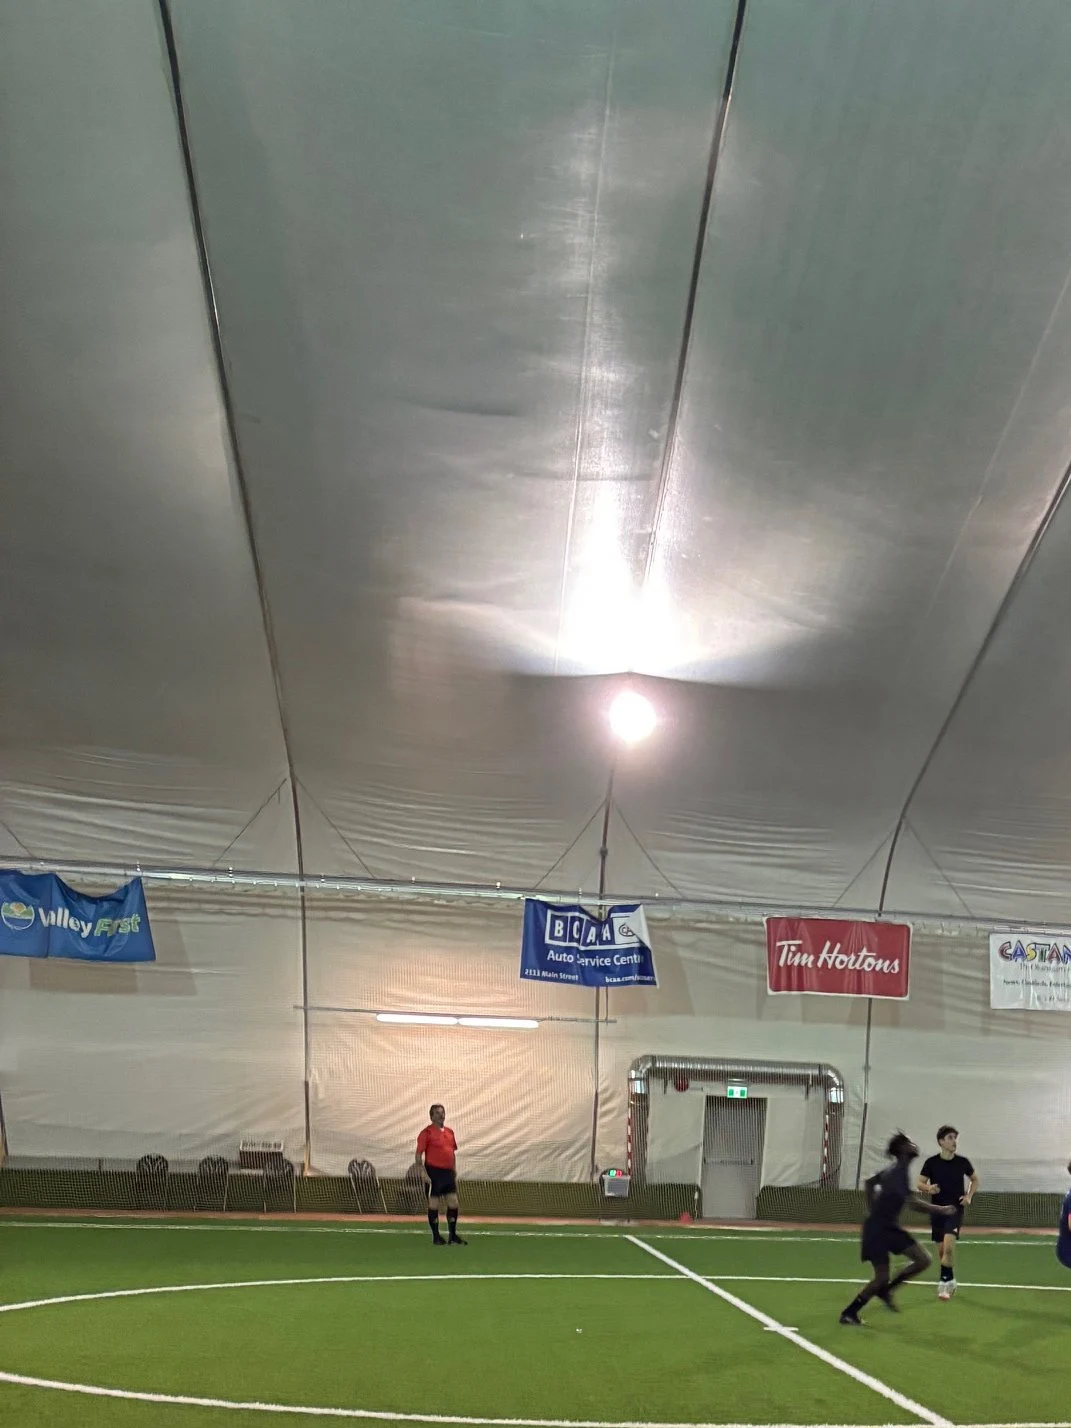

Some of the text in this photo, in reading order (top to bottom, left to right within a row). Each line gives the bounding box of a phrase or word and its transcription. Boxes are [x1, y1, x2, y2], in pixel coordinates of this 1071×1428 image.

[554, 920, 611, 943] BCAA
[547, 950, 574, 963] Auto
[776, 940, 900, 974] Tim Hortons
[559, 973, 578, 981] Street
